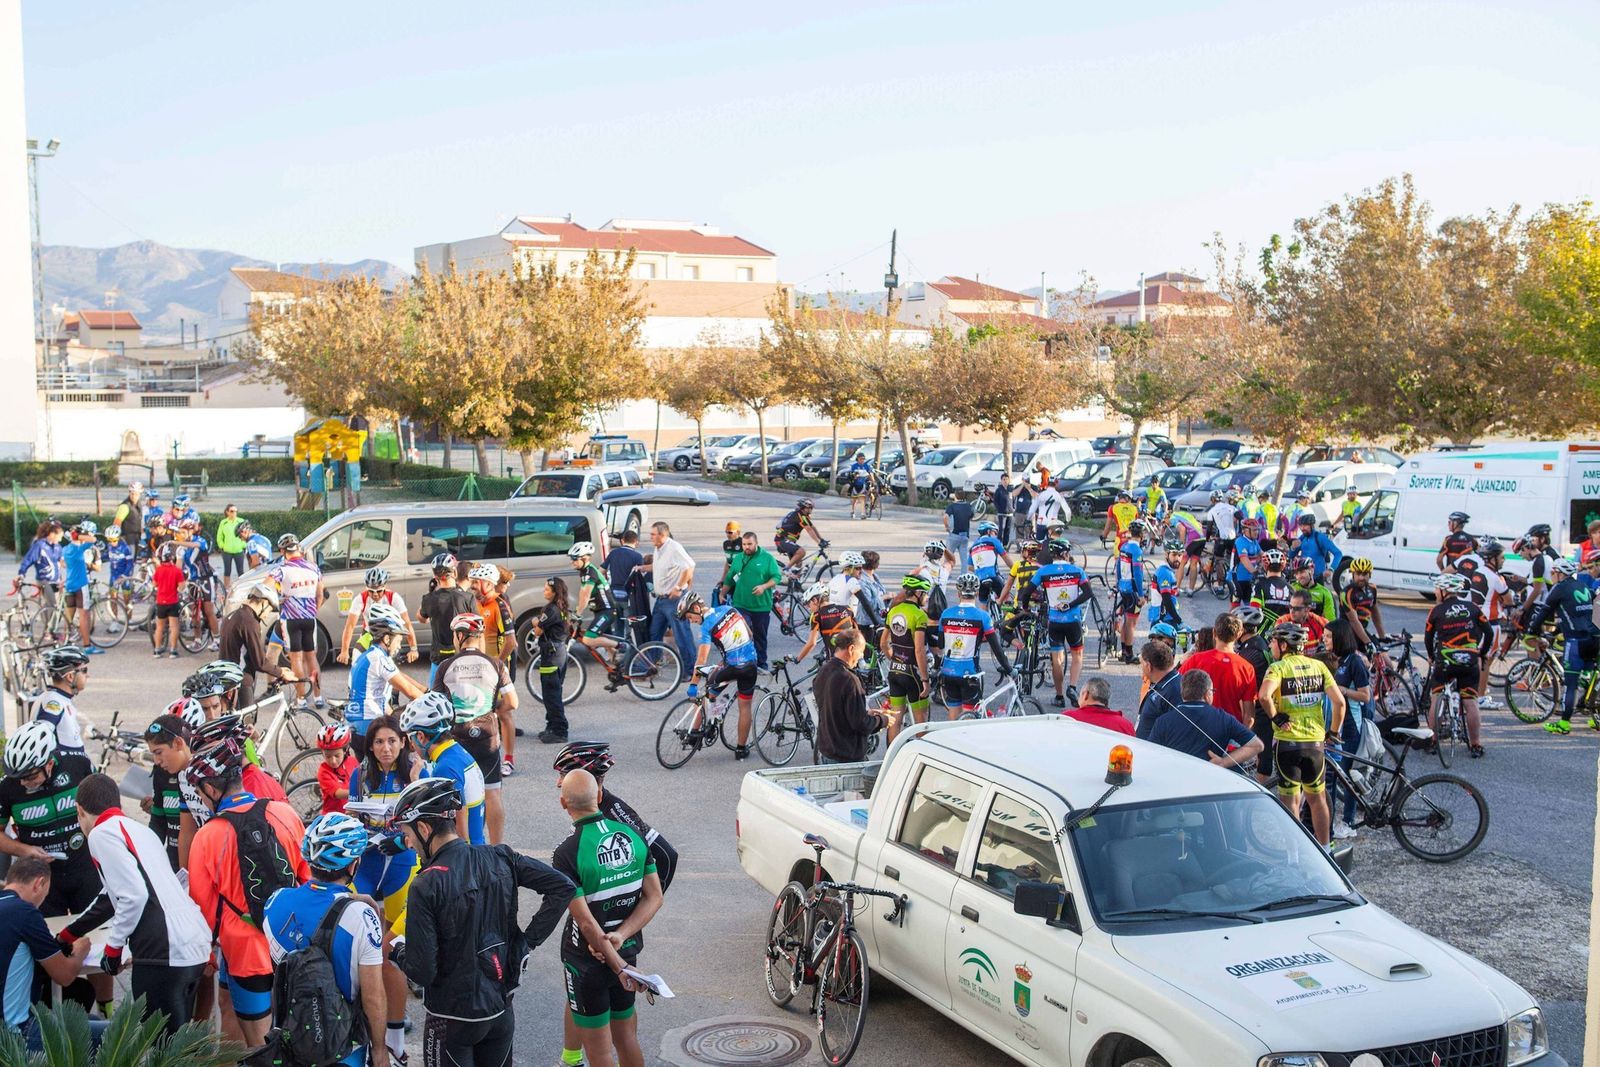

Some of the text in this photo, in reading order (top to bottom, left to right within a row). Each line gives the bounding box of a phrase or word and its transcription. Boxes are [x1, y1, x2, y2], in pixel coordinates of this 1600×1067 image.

[1409, 474, 1517, 493] SOPORTE VITAL AVANZADO
[892, 662, 906, 671] FBS
[184, 794, 203, 805] GIAN
[167, 822, 181, 831] bric
[598, 849, 621, 865] MTB
[1225, 951, 1331, 977] ORGANIZACIÓN
[1276, 989, 1324, 1004] AYUNTAMIENTO
[312, 996, 323, 1044] Quechua
